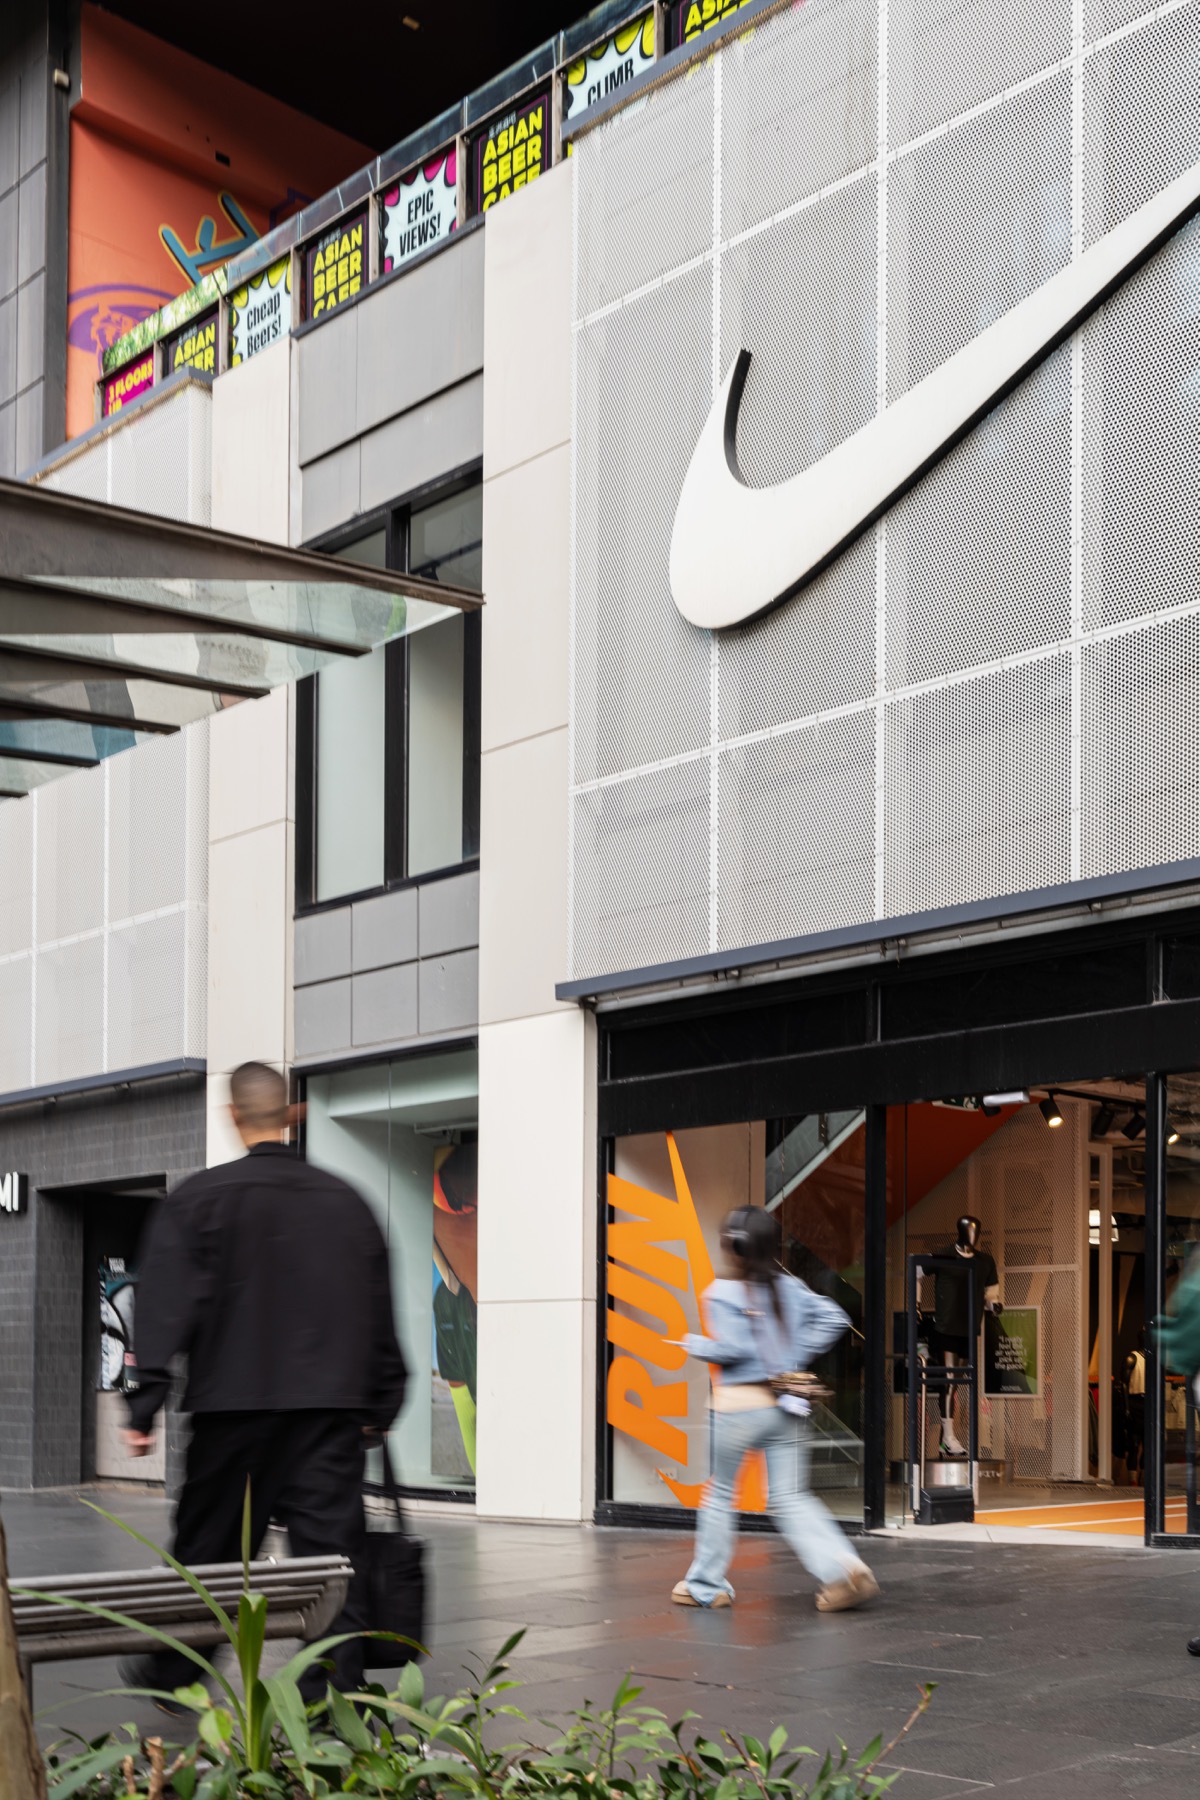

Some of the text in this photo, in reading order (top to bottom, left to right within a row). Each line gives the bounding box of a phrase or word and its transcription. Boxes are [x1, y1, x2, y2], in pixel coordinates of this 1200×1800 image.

[483, 106, 542, 166] ASIAN
[483, 135, 541, 195] BEER
[408, 189, 434, 224] EPIC
[313, 224, 362, 275] ASIAN
[400, 212, 441, 257] VIEWS!
[314, 249, 361, 301] BEER
[247, 292, 280, 330] Cheap
[174, 322, 215, 368] ASIAN
[247, 313, 281, 358] Beers!
[115, 358, 153, 398] FLOORS
